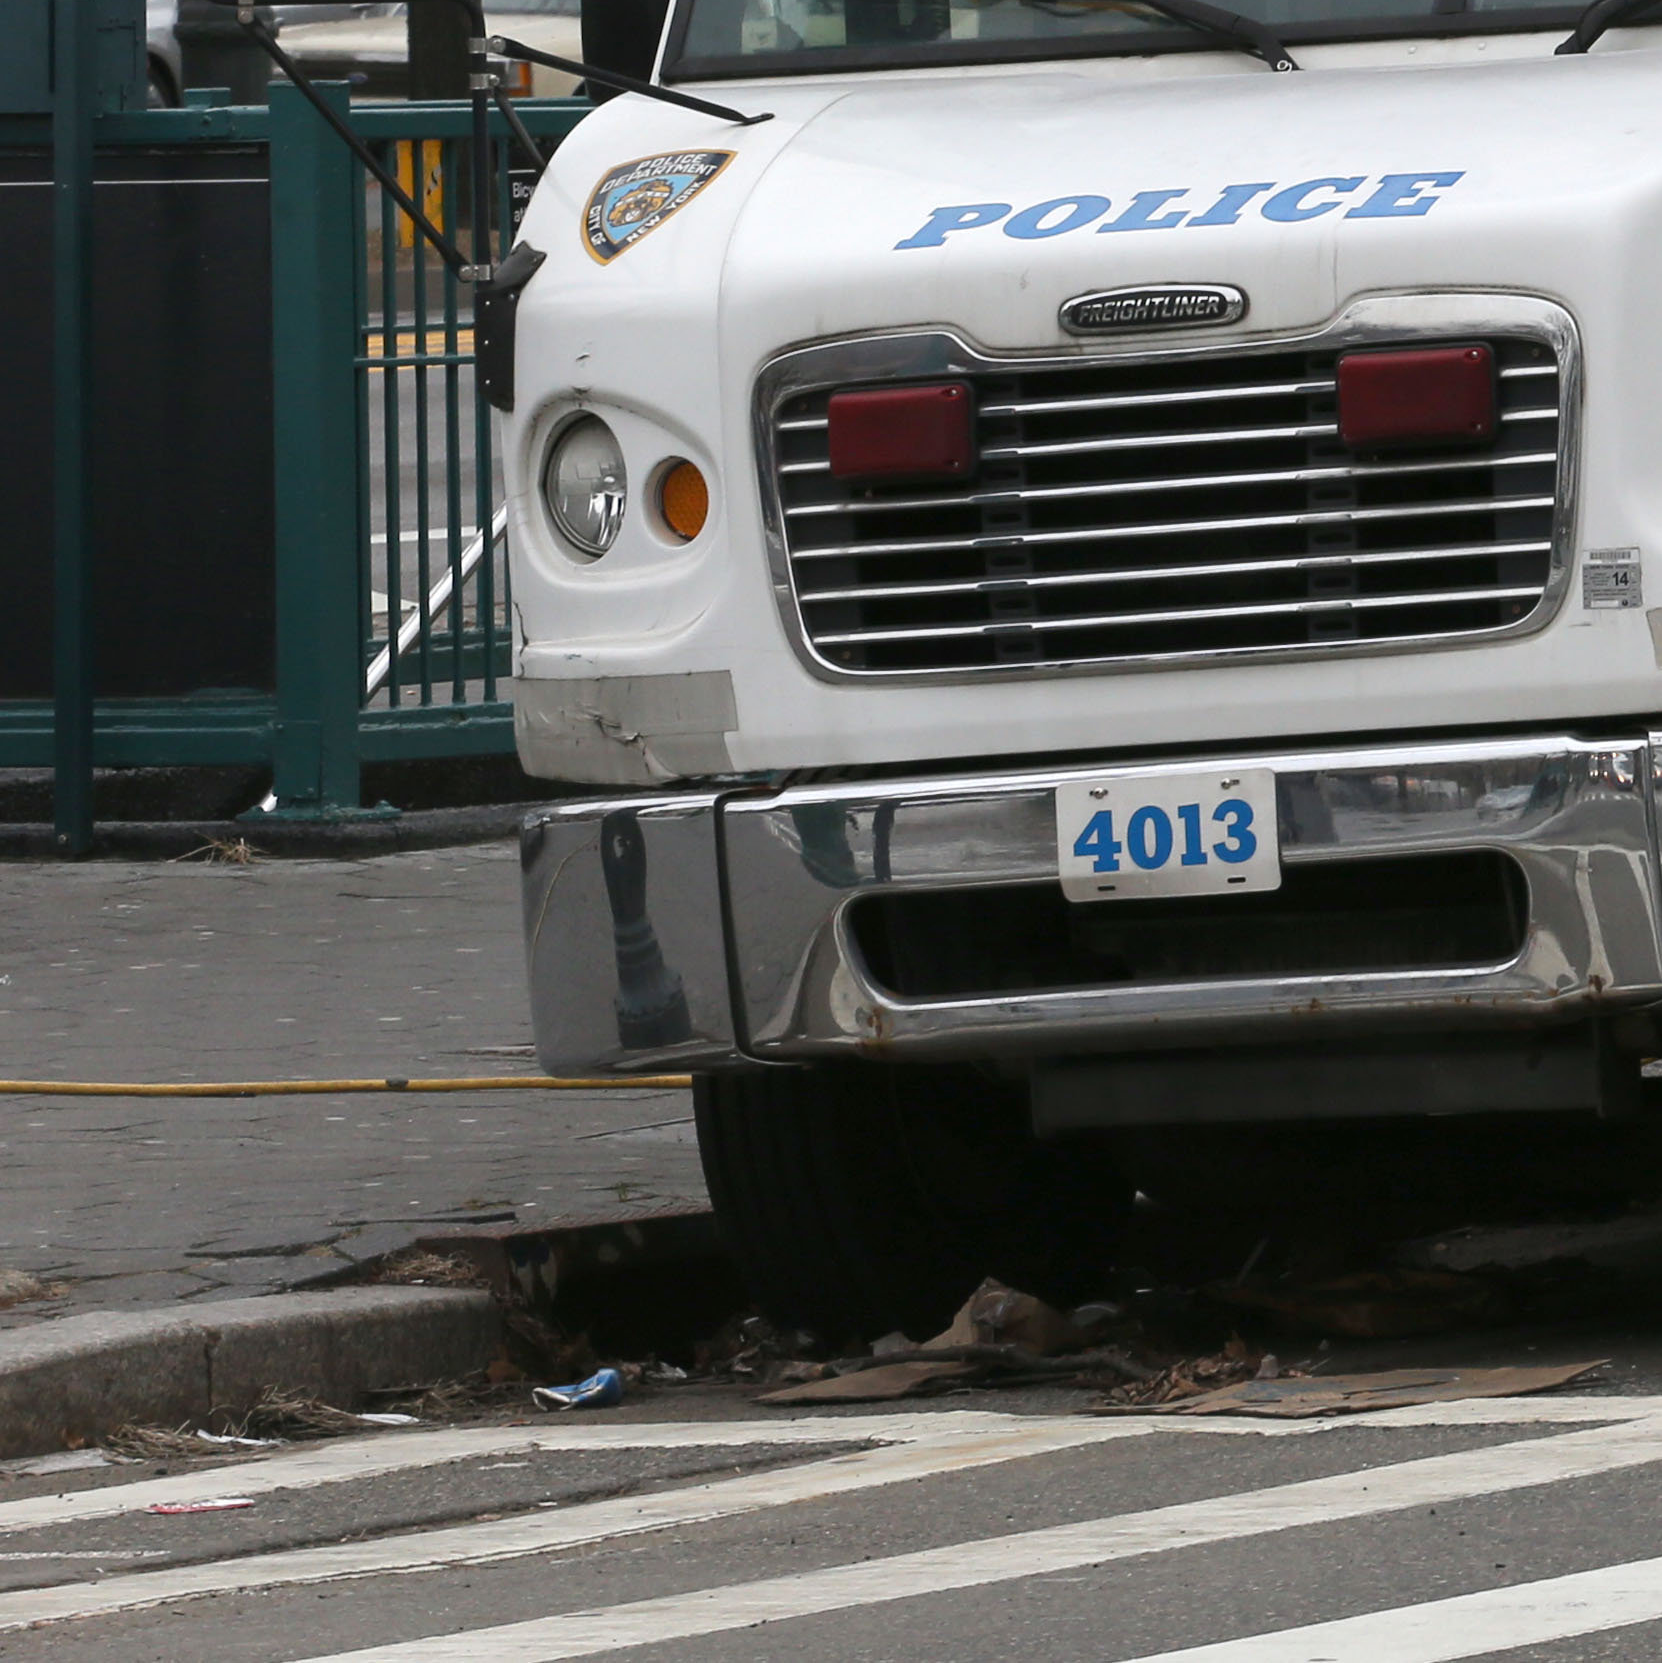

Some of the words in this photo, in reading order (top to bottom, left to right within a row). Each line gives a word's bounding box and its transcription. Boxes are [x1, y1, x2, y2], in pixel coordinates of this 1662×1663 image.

[636, 153, 708, 172] POLICE
[599, 163, 718, 195] DEPARTMENT
[666, 180, 707, 210] YORK
[588, 204, 602, 231] CITY
[894, 170, 1466, 250] POLICE
[590, 232, 607, 246] OF
[625, 214, 661, 243] NEW
[1077, 295, 1221, 324] FREIGHTLINER
[1612, 571, 1630, 587] 14
[1072, 798, 1258, 874] 4013
